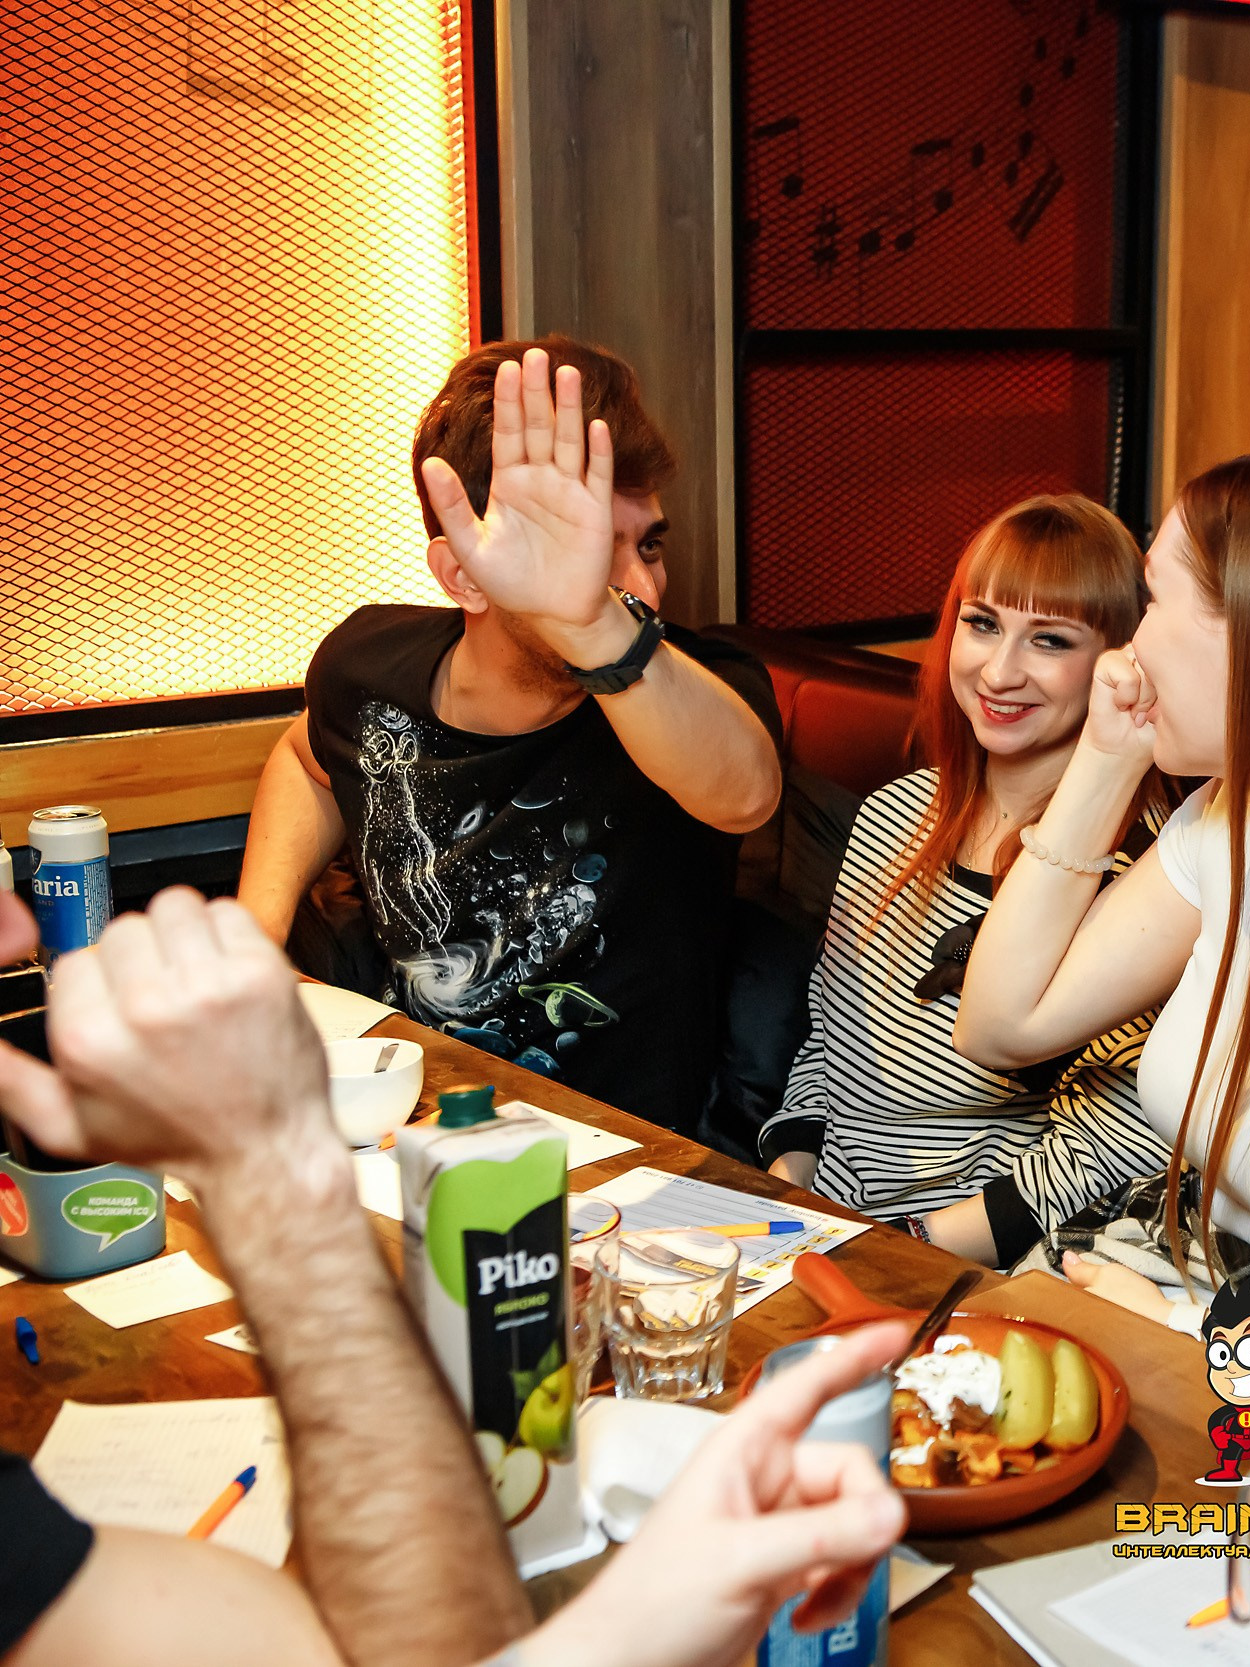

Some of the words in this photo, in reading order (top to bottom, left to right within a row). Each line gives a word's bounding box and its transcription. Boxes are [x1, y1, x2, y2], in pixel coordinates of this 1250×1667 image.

[32, 875, 80, 897] aria
[88, 1197, 138, 1206] КОМАНДА
[478, 1250, 560, 1295] Piko
